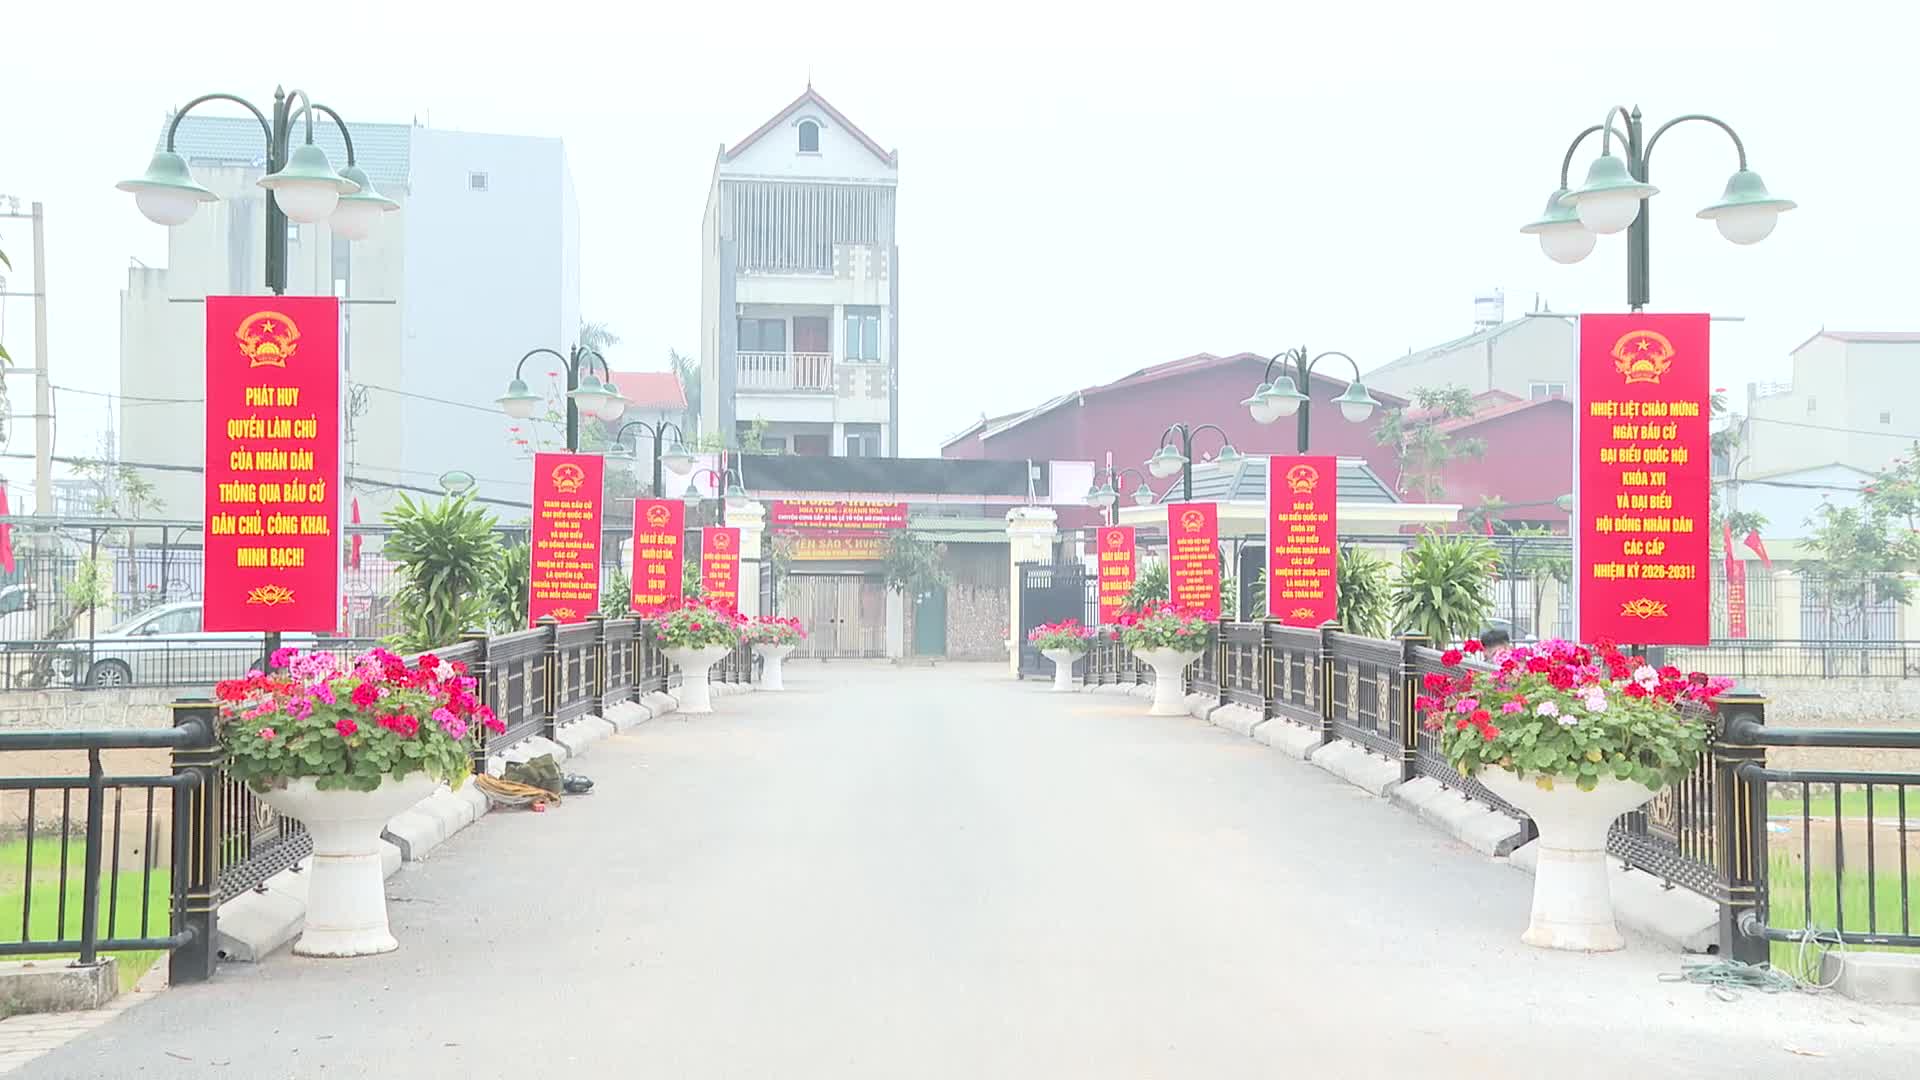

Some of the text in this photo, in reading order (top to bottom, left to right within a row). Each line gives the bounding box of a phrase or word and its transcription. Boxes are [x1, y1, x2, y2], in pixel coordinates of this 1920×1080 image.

[246, 383, 297, 405] PHÁT HUY
[1591, 398, 1698, 419] NHIỆT LIỆT CHÀO MỪNG
[228, 414, 316, 440] QUYỀN LÀM CHỦ
[1613, 421, 1675, 439] NGÀY BẦU CỬ
[231, 447, 313, 469] CỦA NHÂN DÂN
[1601, 444, 1687, 465] ĐẠI BIỂU QUỐC HỘI
[1623, 468, 1665, 485] KHÓA XVI
[221, 478, 324, 504] THÔNG QUA BẦU CỬ
[1617, 490, 1671, 511] VÀ ĐẠI BIỂU
[212, 511, 330, 536] DÂN CHỦ, CÔNG KHAI,
[1597, 513, 1692, 534] HỘI ĐỒNG NHÂN DÂN
[1624, 536, 1664, 554] CÁC CẤP
[238, 548, 304, 569] MINH BẠCH!
[1594, 561, 1694, 581] NHIỆM KỲ 2026-2031!
